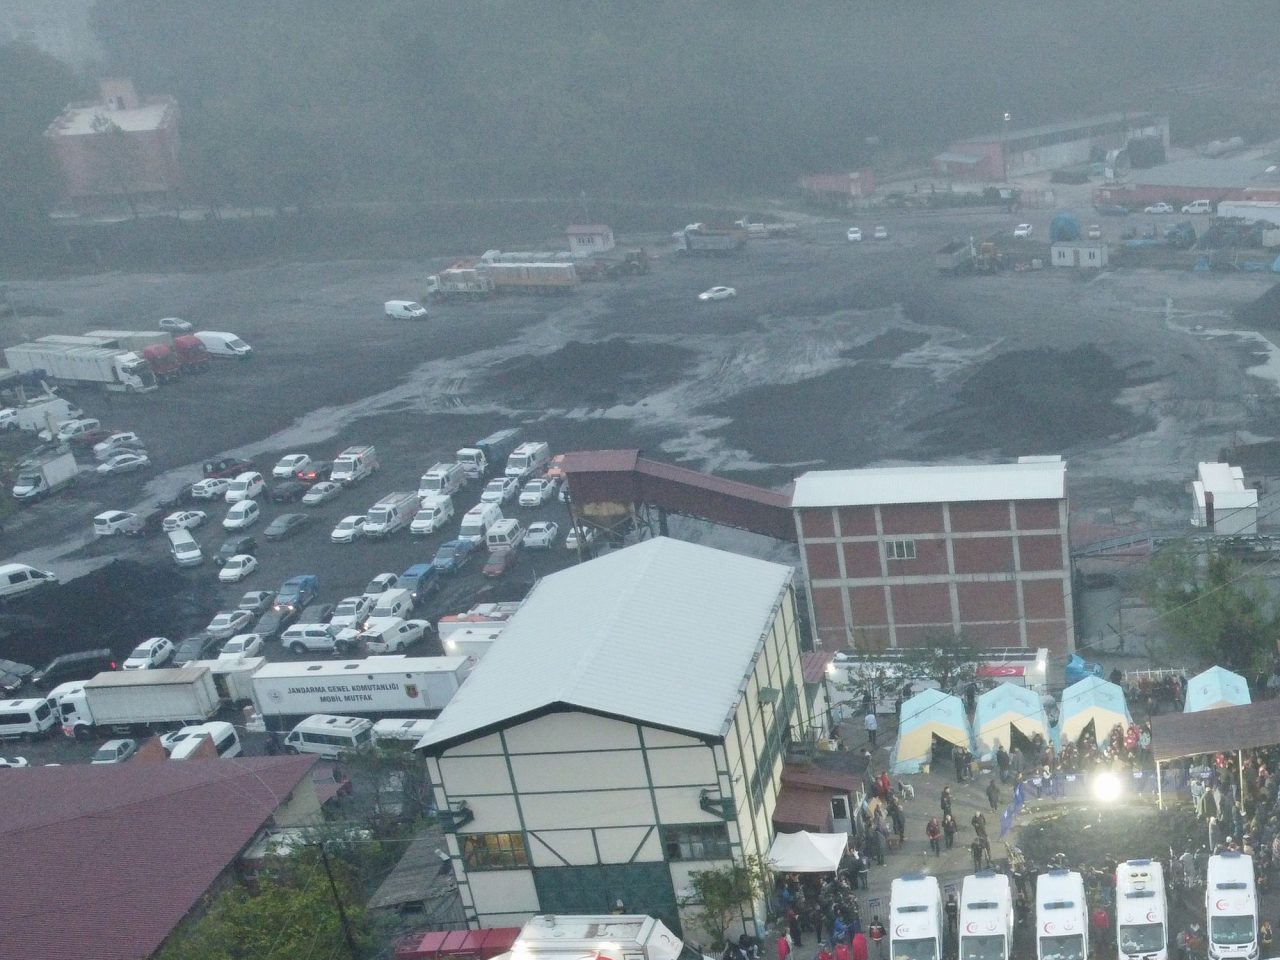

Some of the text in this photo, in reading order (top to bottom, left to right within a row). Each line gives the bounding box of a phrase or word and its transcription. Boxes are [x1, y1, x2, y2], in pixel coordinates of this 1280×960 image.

[328, 685, 350, 693] GENEL
[352, 683, 400, 691] KOMUTANLIĞI
[320, 694, 373, 703] MOBİL MUTFAK
